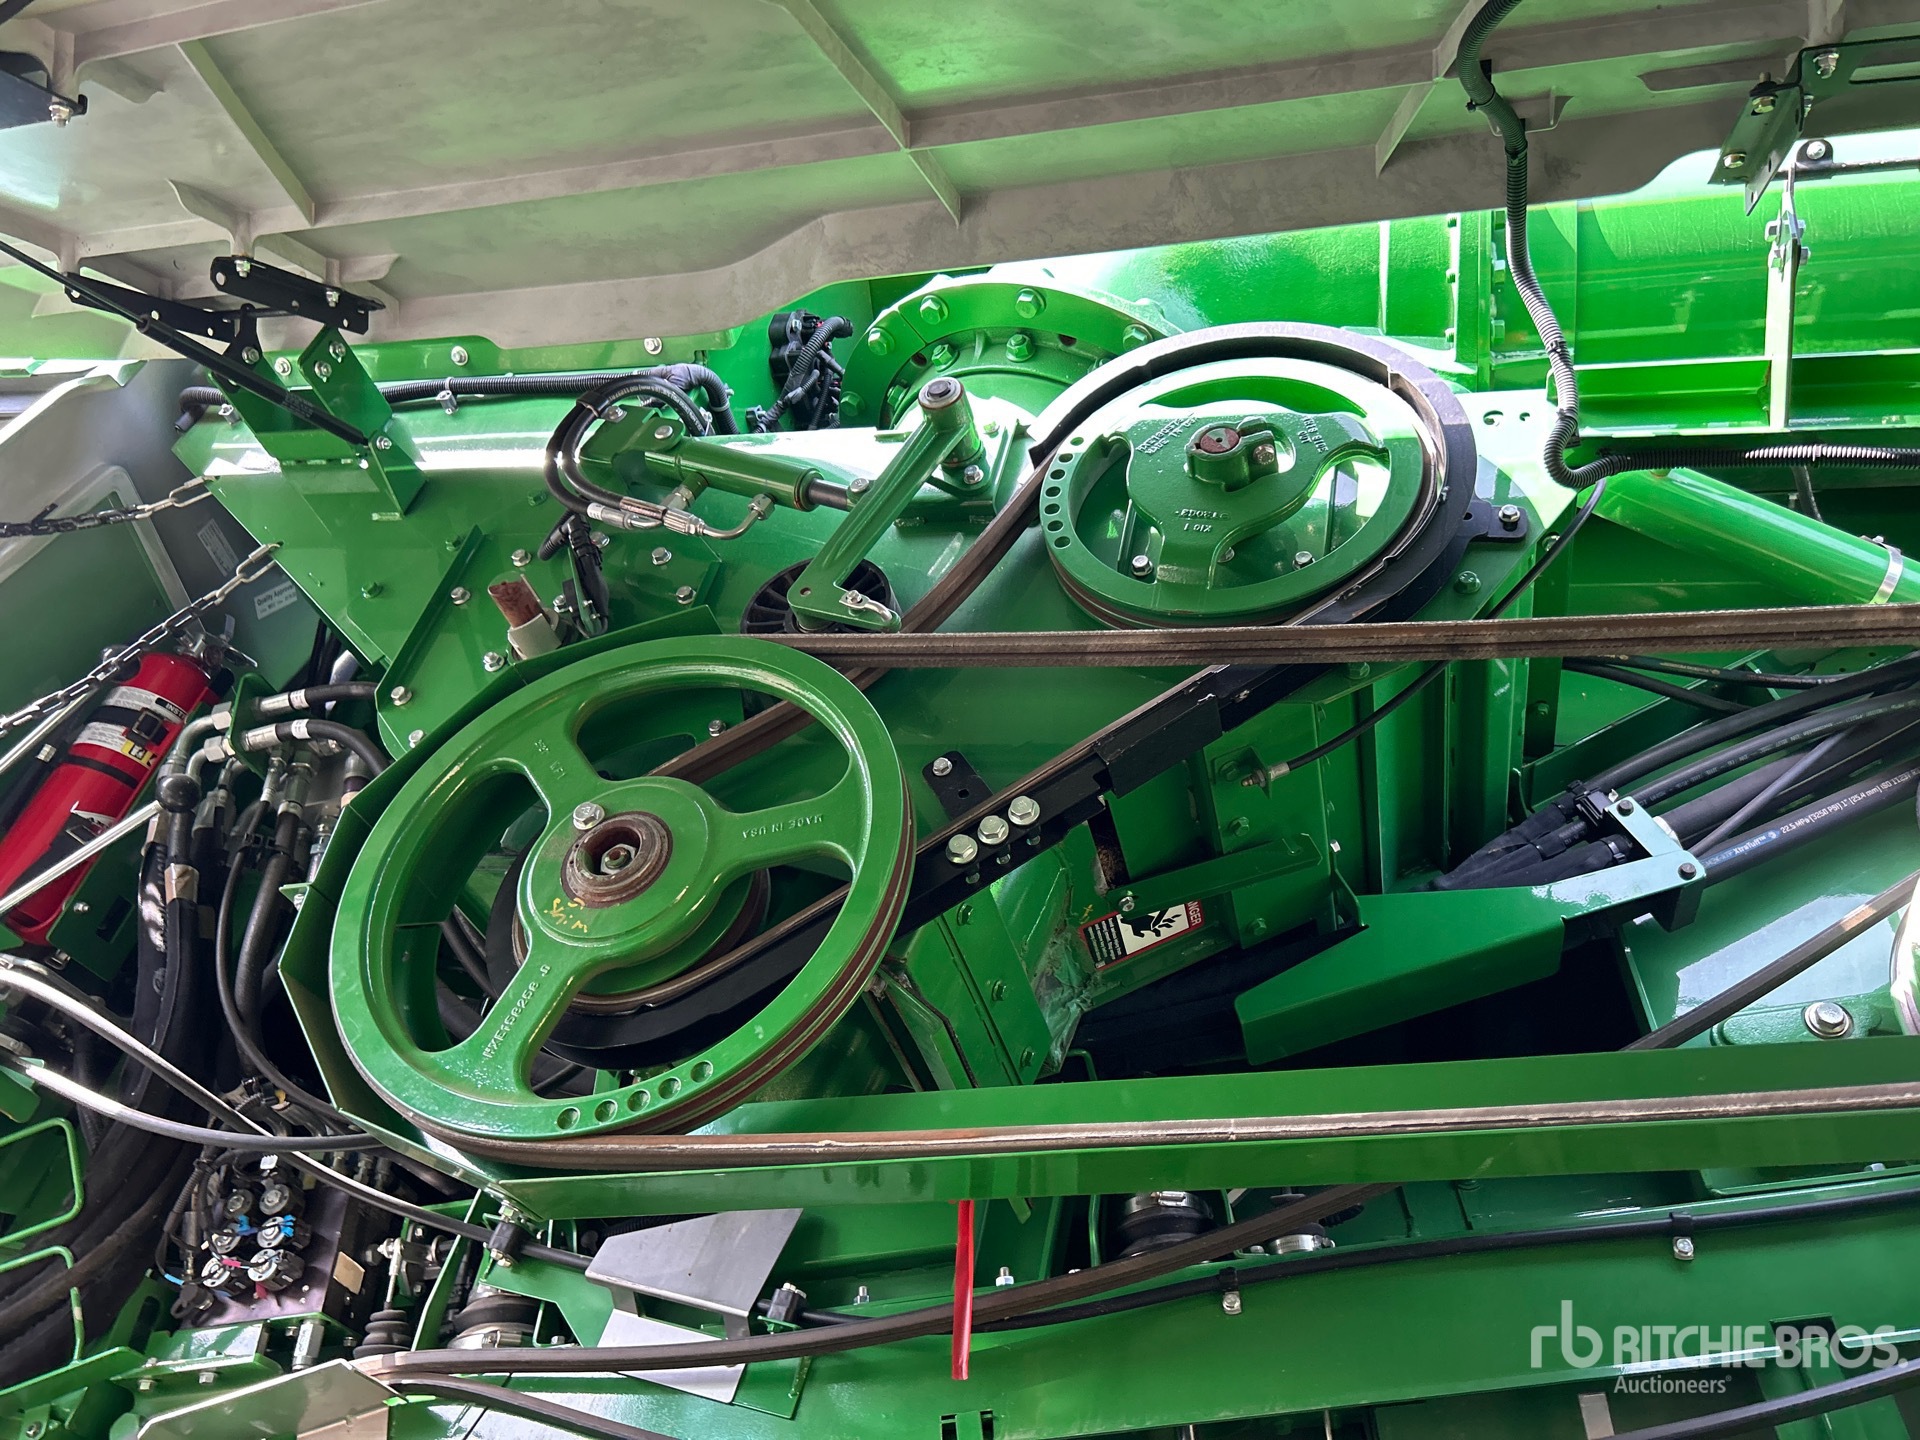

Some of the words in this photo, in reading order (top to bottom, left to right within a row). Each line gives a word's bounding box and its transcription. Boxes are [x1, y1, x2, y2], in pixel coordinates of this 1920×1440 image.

[771, 821, 783, 833] IN
[788, 813, 823, 829] MADE
[1780, 822, 1796, 834] 22.5
[1795, 816, 1810, 829] MPa
[742, 825, 766, 839] USA
[1186, 900, 1202, 926] NGER
